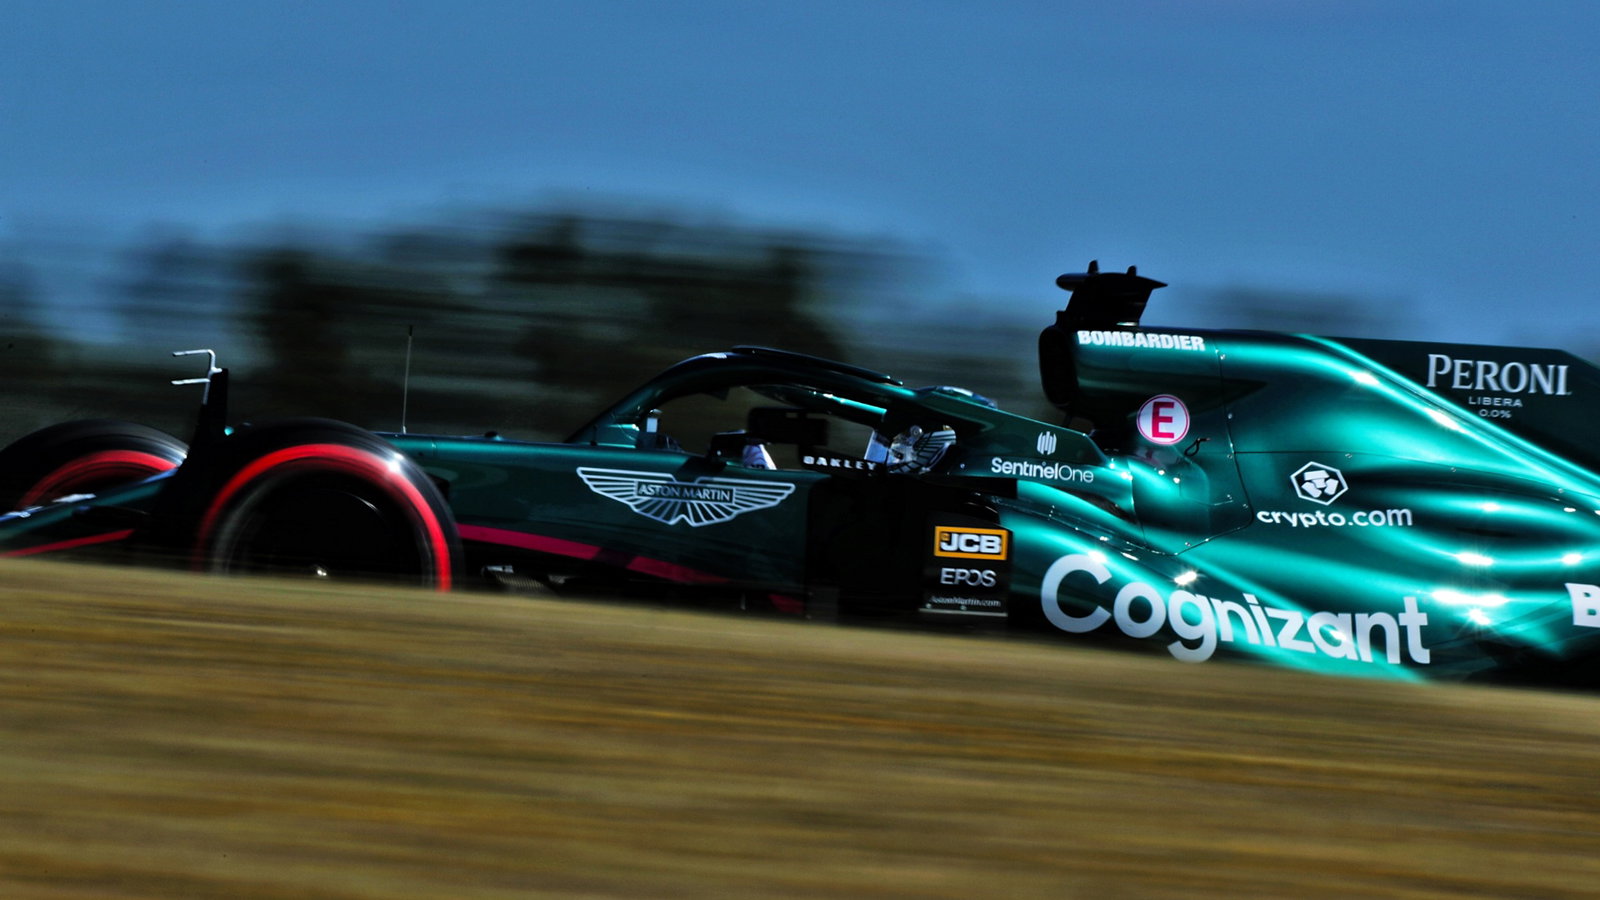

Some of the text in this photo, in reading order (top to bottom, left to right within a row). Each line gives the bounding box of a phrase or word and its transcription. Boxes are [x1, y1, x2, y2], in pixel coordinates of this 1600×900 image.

[1077, 330, 1206, 351] BOMBARDIER
[1426, 353, 1570, 396] PERONI
[1468, 396, 1523, 408] LIBERA
[1152, 401, 1175, 439] E
[1478, 409, 1512, 419] 0.0%
[802, 455, 877, 471] OAKLEY
[991, 457, 1094, 483] SentinelOne
[638, 484, 731, 501] ASTON MARTIN
[1256, 508, 1413, 528] crypto.com
[940, 532, 1002, 554] JCB
[940, 567, 997, 587] EPOS
[1040, 553, 1431, 664] Cognizant
